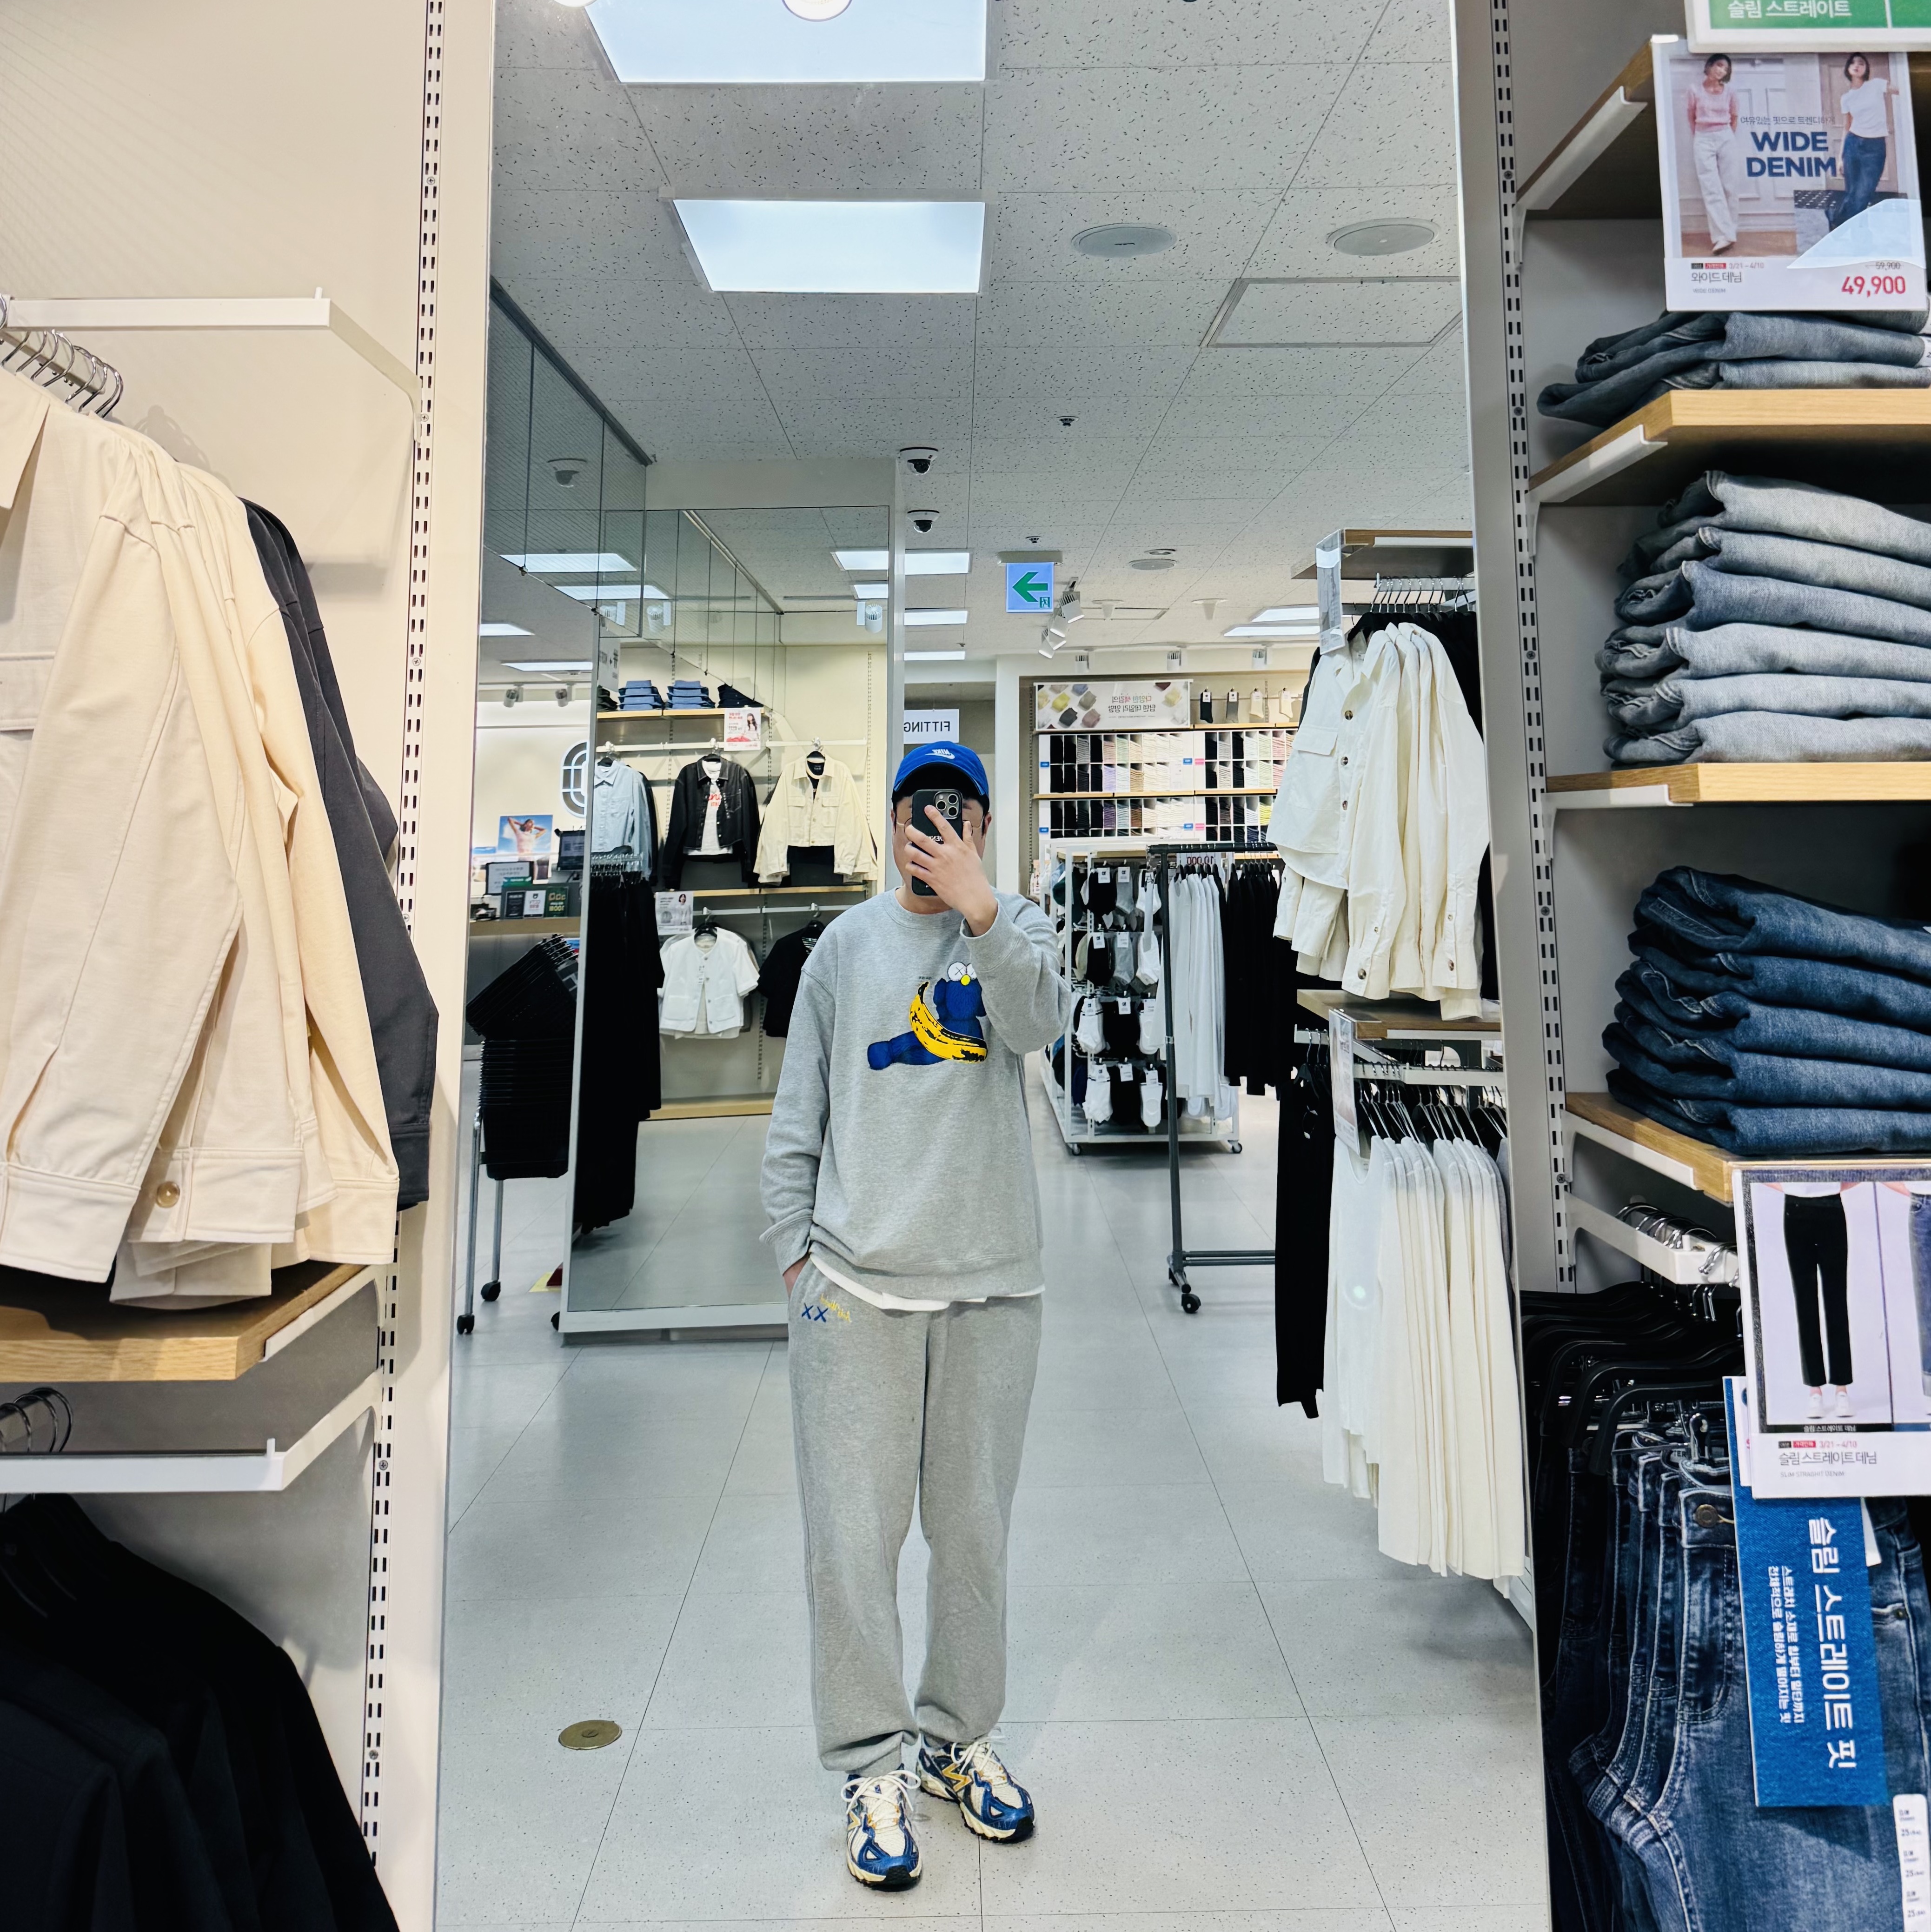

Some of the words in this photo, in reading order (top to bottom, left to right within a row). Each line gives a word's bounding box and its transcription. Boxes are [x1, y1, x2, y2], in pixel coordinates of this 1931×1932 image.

[1728, 0, 1762, 18] 슬림
[1765, 0, 1852, 18] 스트레이트
[1741, 116, 1771, 125] 여유있는
[1773, 116, 1796, 125] 핏으로
[1798, 116, 1835, 125] 트렌디하게
[1751, 132, 1829, 152] WIDE
[1746, 157, 1837, 177] DENIM
[1691, 272, 1721, 283] 와이드
[1722, 272, 1742, 283] 데님
[1876, 262, 1901, 271] 59,900
[1842, 276, 1905, 298] 49,900
[1778, 1452, 1799, 1466] 슬림
[1801, 1451, 1855, 1464] 스트레이트
[1856, 1451, 1877, 1464] 데님
[1808, 1517, 1840, 1573] 슬림
[1768, 1566, 1783, 1619] 전체적으로
[1781, 1565, 1796, 1608] 스트레치
[1785, 1611, 1798, 1643] 소재로
[1773, 1621, 1786, 1664] 슬림하게
[1788, 1646, 1801, 1677] 힙부터
[1815, 1584, 1853, 1731] 스트레이트
[1776, 1666, 1790, 1710] 떨어지는
[1780, 1712, 1791, 1723] 핏
[1827, 1739, 1857, 1768] 핏
